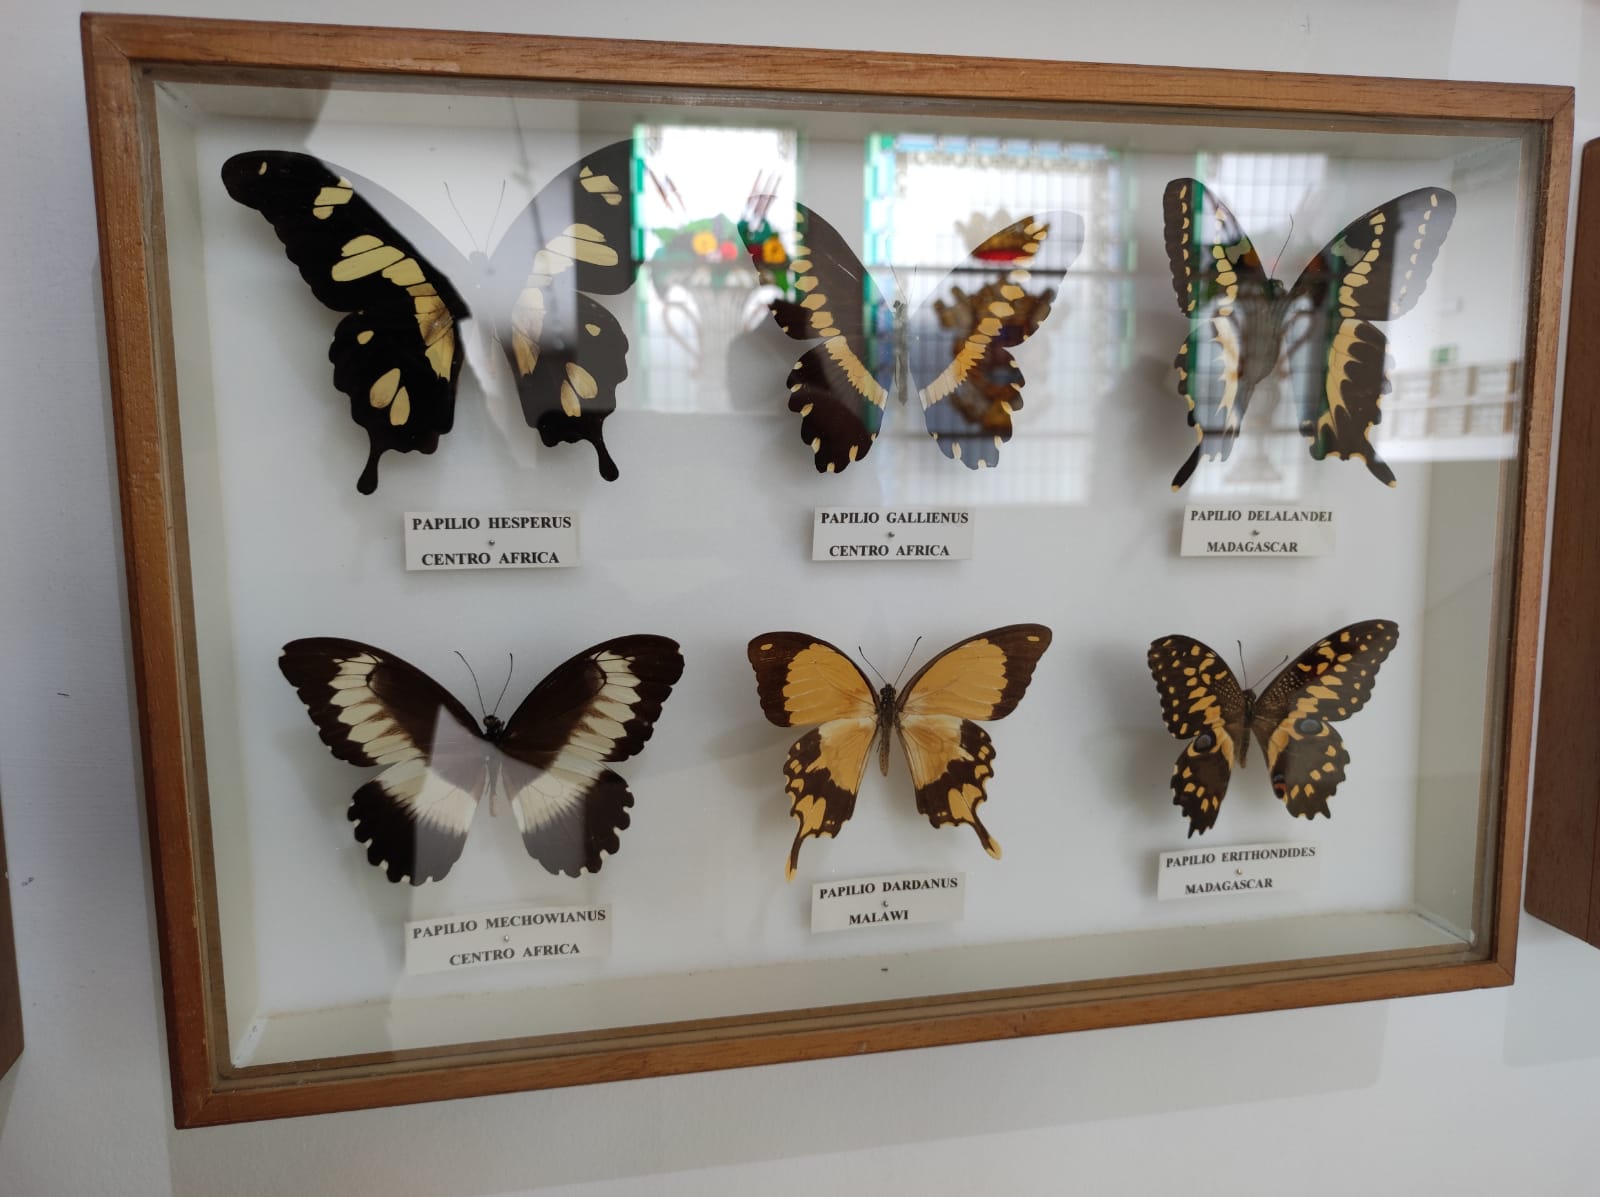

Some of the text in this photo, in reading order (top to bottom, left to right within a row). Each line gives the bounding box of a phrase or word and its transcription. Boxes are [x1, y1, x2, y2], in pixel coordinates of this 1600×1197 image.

[412, 516, 572, 530] PAPILIO HESPERUS
[821, 512, 969, 524] PAPILIO GALLIENUS
[1190, 510, 1333, 522] PAPILIO DELALANDEI
[829, 545, 950, 557] CENTRO AFRICA
[1206, 541, 1298, 553] MADAGASCAR
[421, 552, 560, 566] CENTRO AFRICA
[1166, 847, 1316, 868] PAPILIO ERITHONDIDES
[819, 877, 958, 899] PAPILIO DARDANUS
[1184, 878, 1273, 894] MADAGASCAR
[413, 909, 606, 939] PAPILIO MECHOWIANUS
[848, 910, 909, 925] MALAWI
[449, 943, 580, 966] CENTRO AFRICA
